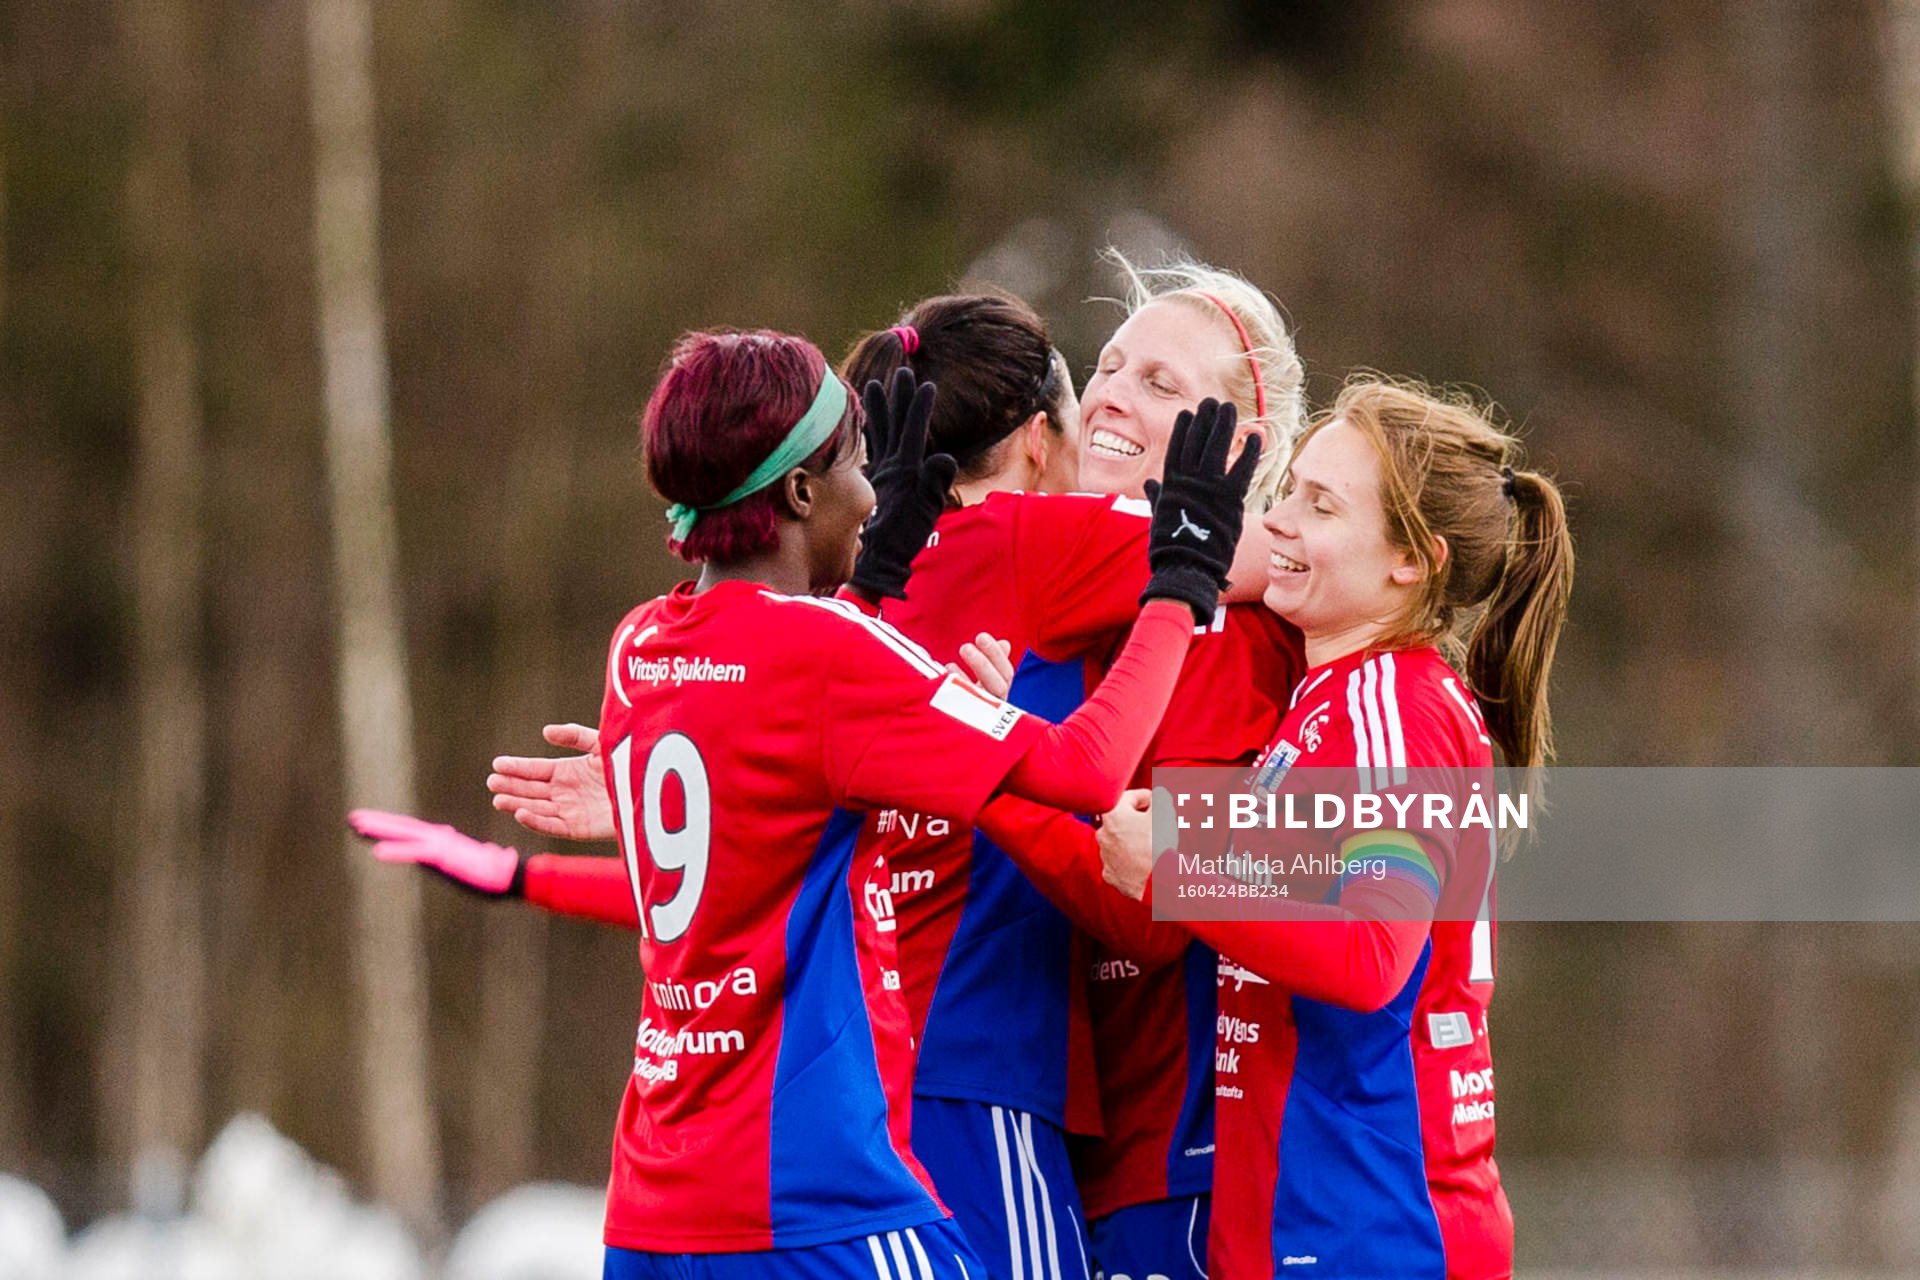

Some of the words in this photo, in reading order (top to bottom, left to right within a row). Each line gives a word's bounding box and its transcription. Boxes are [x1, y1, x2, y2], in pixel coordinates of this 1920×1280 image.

[628, 656, 669, 687] Vittsjö
[671, 656, 746, 687] Sjukhem
[611, 730, 711, 945] 19
